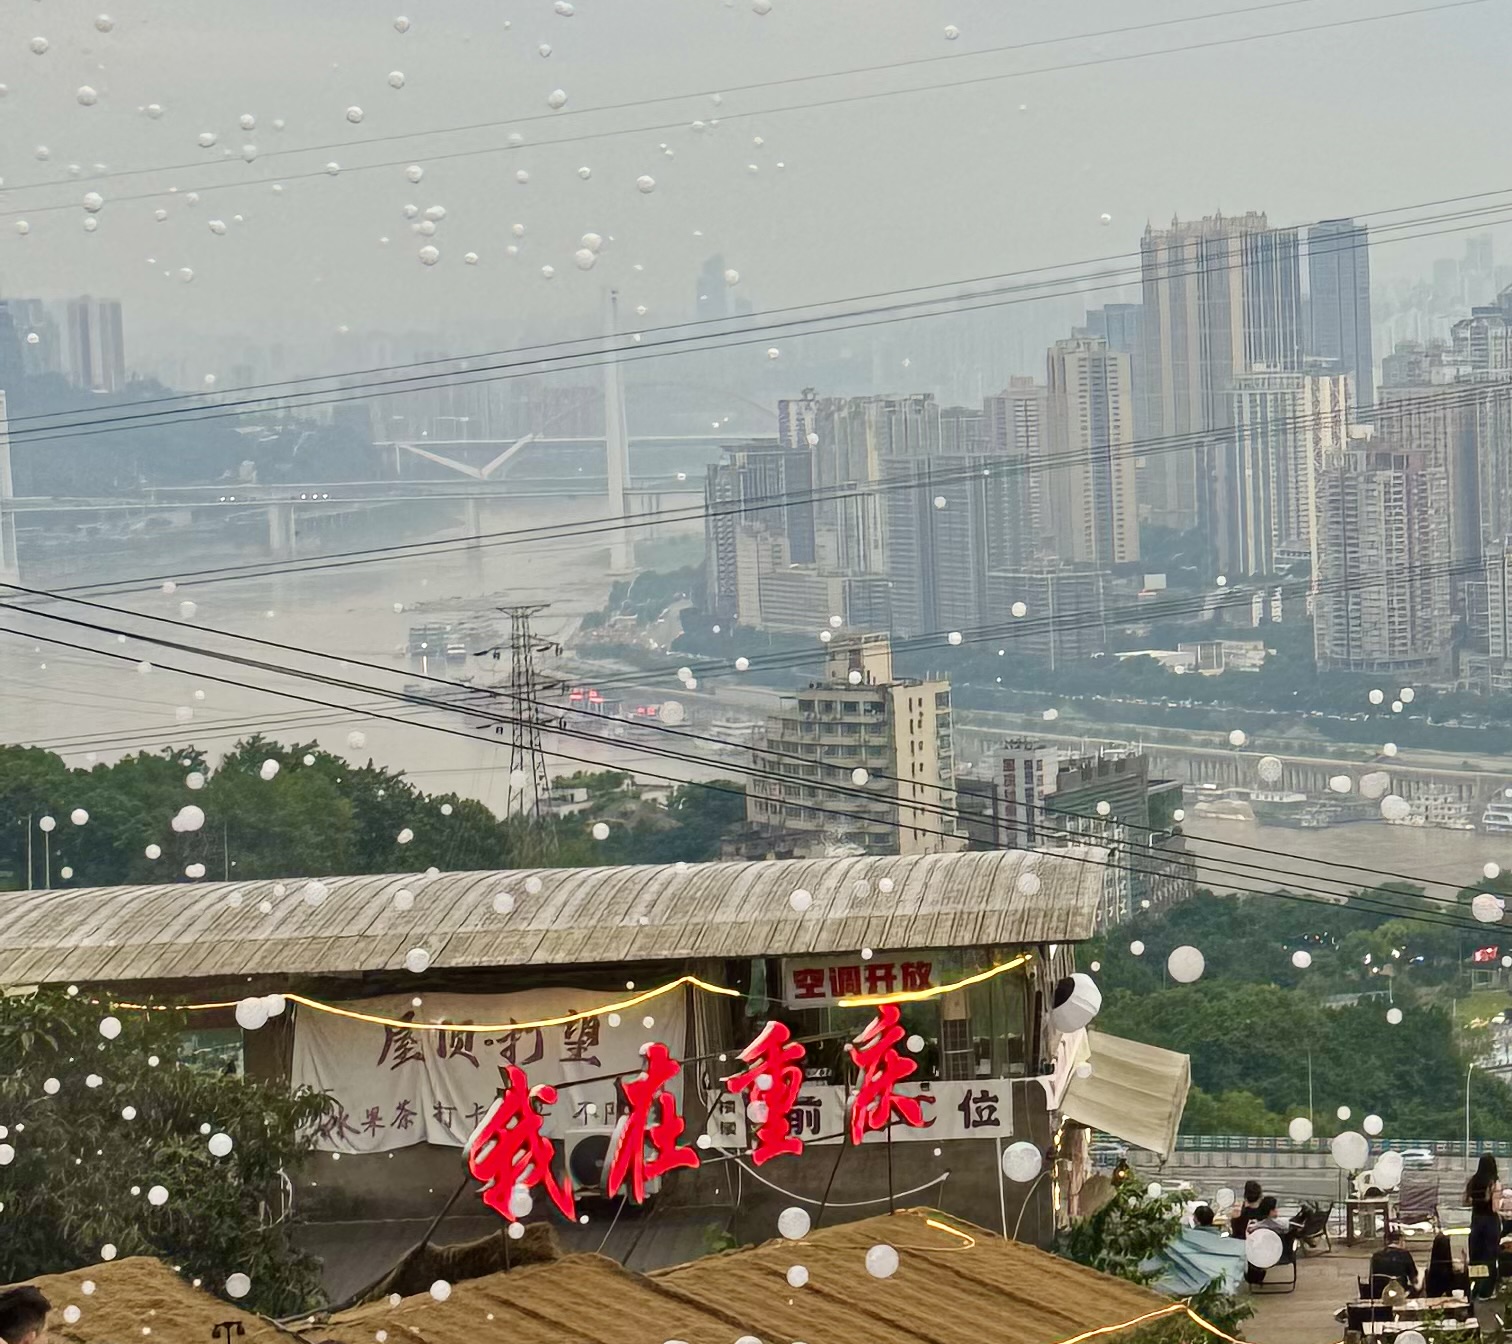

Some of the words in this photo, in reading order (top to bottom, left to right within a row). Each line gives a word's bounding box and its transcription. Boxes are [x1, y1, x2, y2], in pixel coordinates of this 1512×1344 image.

[793, 960, 933, 998] 空调开放
[465, 1005, 935, 1222] 我在重庆
